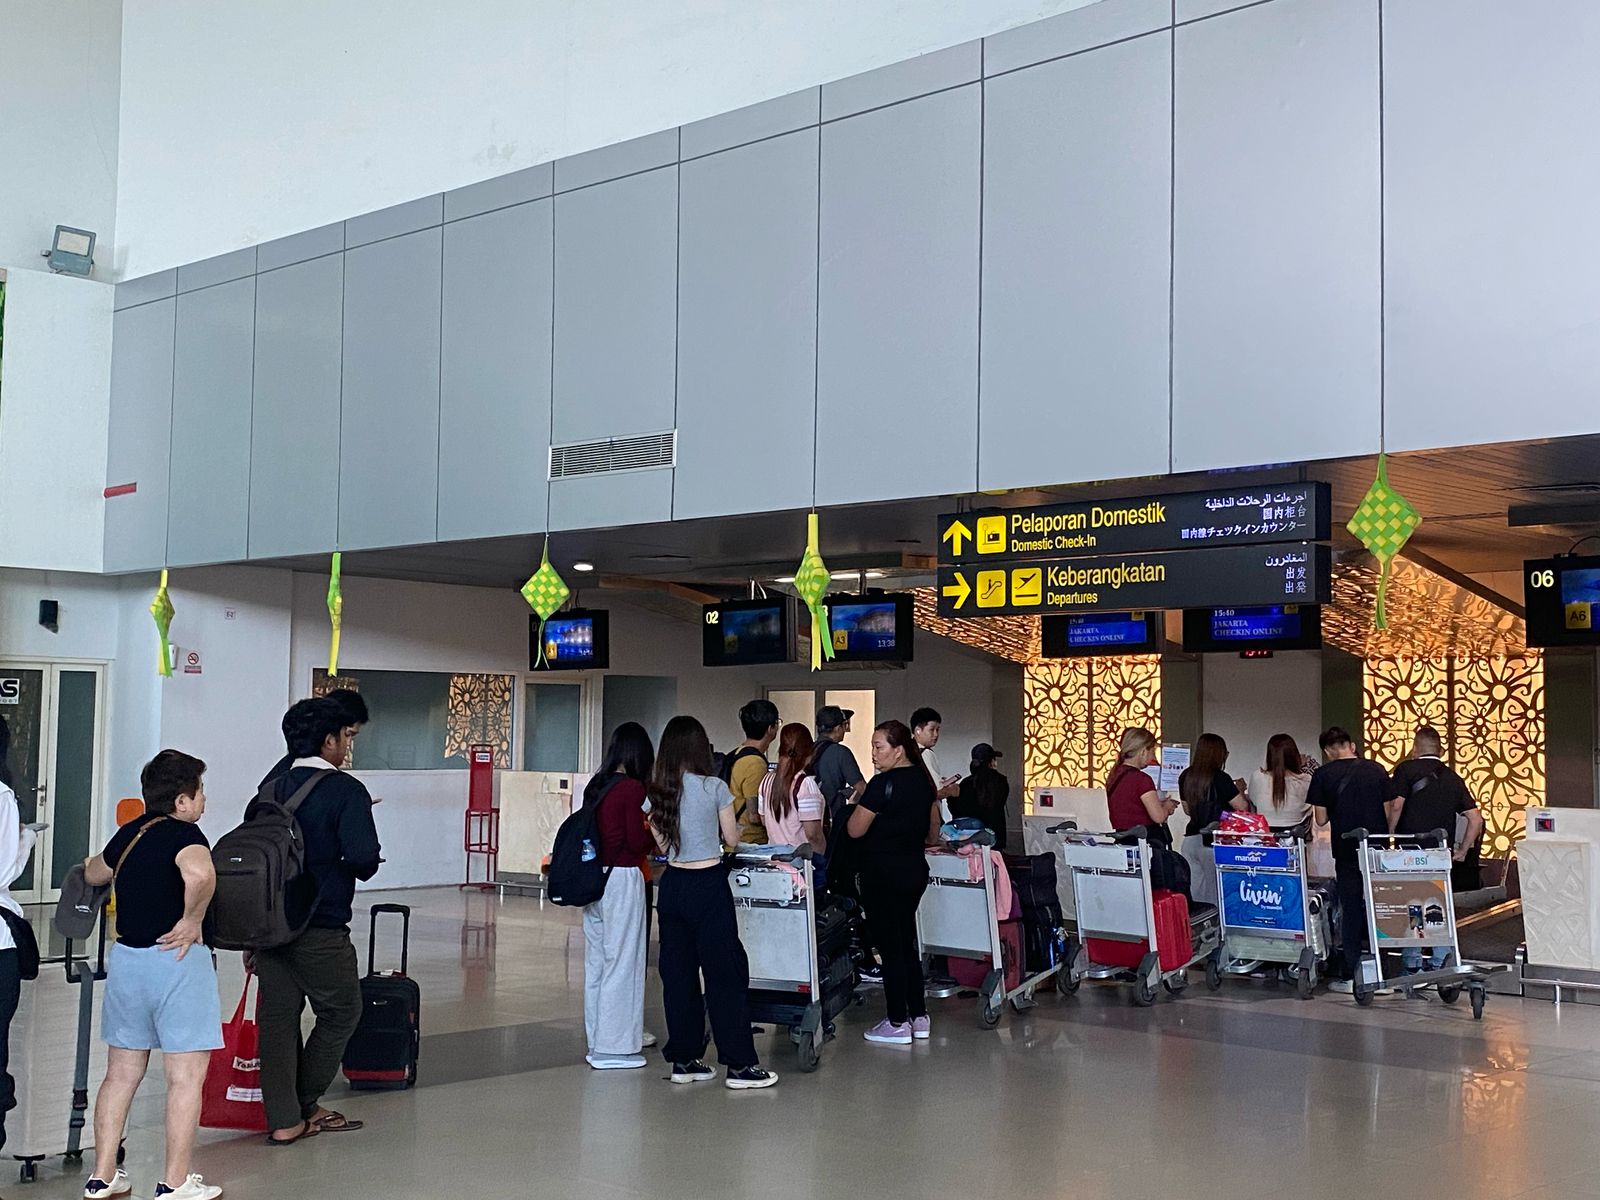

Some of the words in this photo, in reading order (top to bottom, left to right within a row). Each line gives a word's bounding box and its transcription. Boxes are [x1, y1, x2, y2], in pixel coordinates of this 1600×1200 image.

[1236, 493, 1272, 507] الرحلات
[1011, 513, 1087, 537] Pelaporan
[1091, 502, 1166, 528] Domestik
[1011, 538, 1054, 553] Domestic
[1055, 534, 1097, 549] Check-In
[1047, 562, 1166, 589] Keberangkatan
[1285, 566, 1307, 579] 出发
[1531, 569, 1554, 588] 06
[1047, 591, 1098, 608] Departures
[705, 610, 719, 624] 02
[1570, 610, 1587, 622] A6
[1214, 620, 1248, 629] JAKARTA
[1069, 635, 1100, 643] CHECKIN
[1214, 628, 1251, 637] CHECKIN
